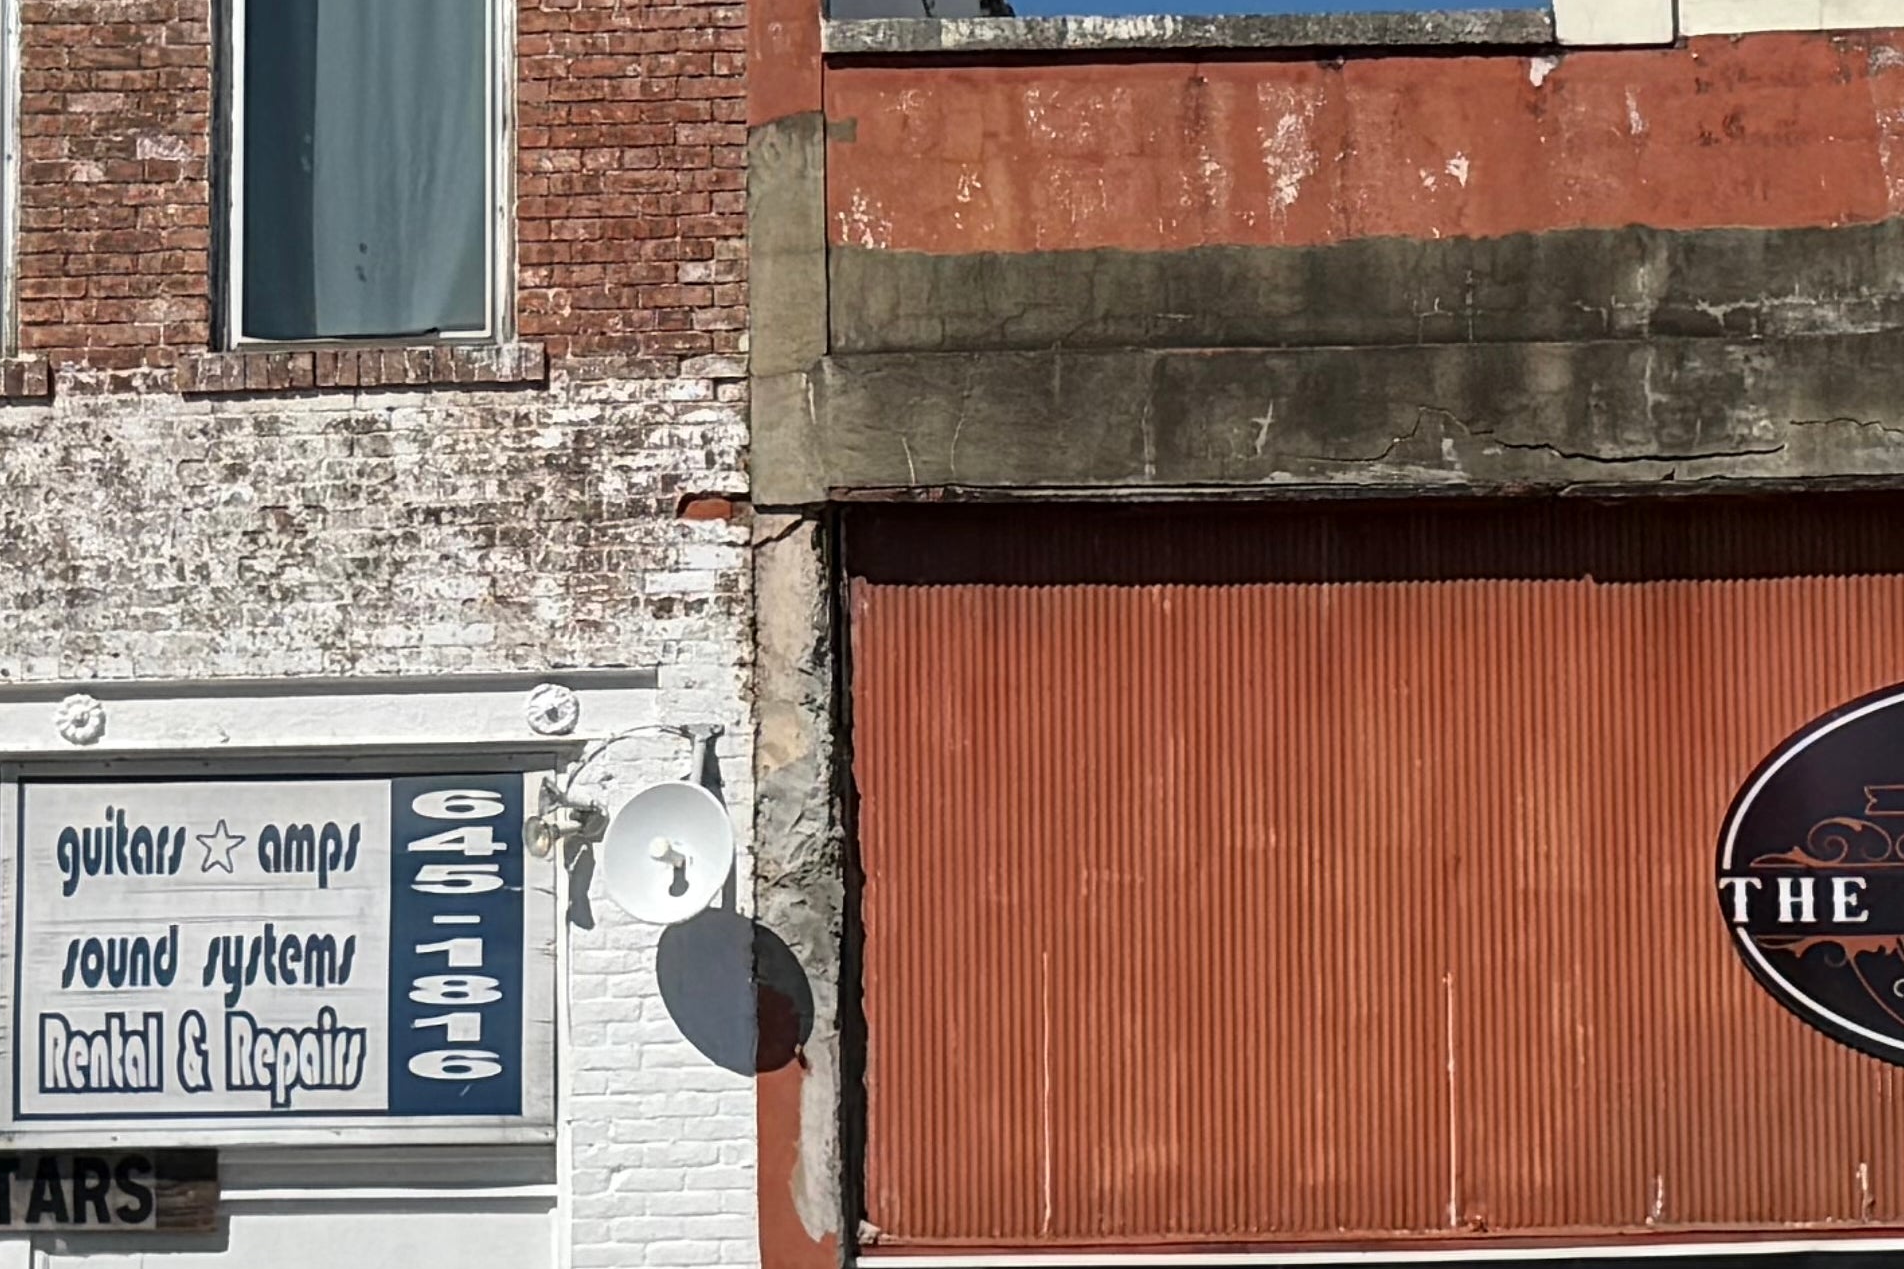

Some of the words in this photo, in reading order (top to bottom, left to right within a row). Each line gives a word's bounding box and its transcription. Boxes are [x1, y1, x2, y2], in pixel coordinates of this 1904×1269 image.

[57, 805, 186, 897] guitars
[257, 821, 361, 889] amps
[1719, 876, 1870, 923] THE
[62, 923, 179, 989] sound
[202, 922, 356, 1008] systems
[39, 1011, 164, 1094] Rental
[177, 1009, 212, 1093] &
[226, 1005, 367, 1108] Repairs
